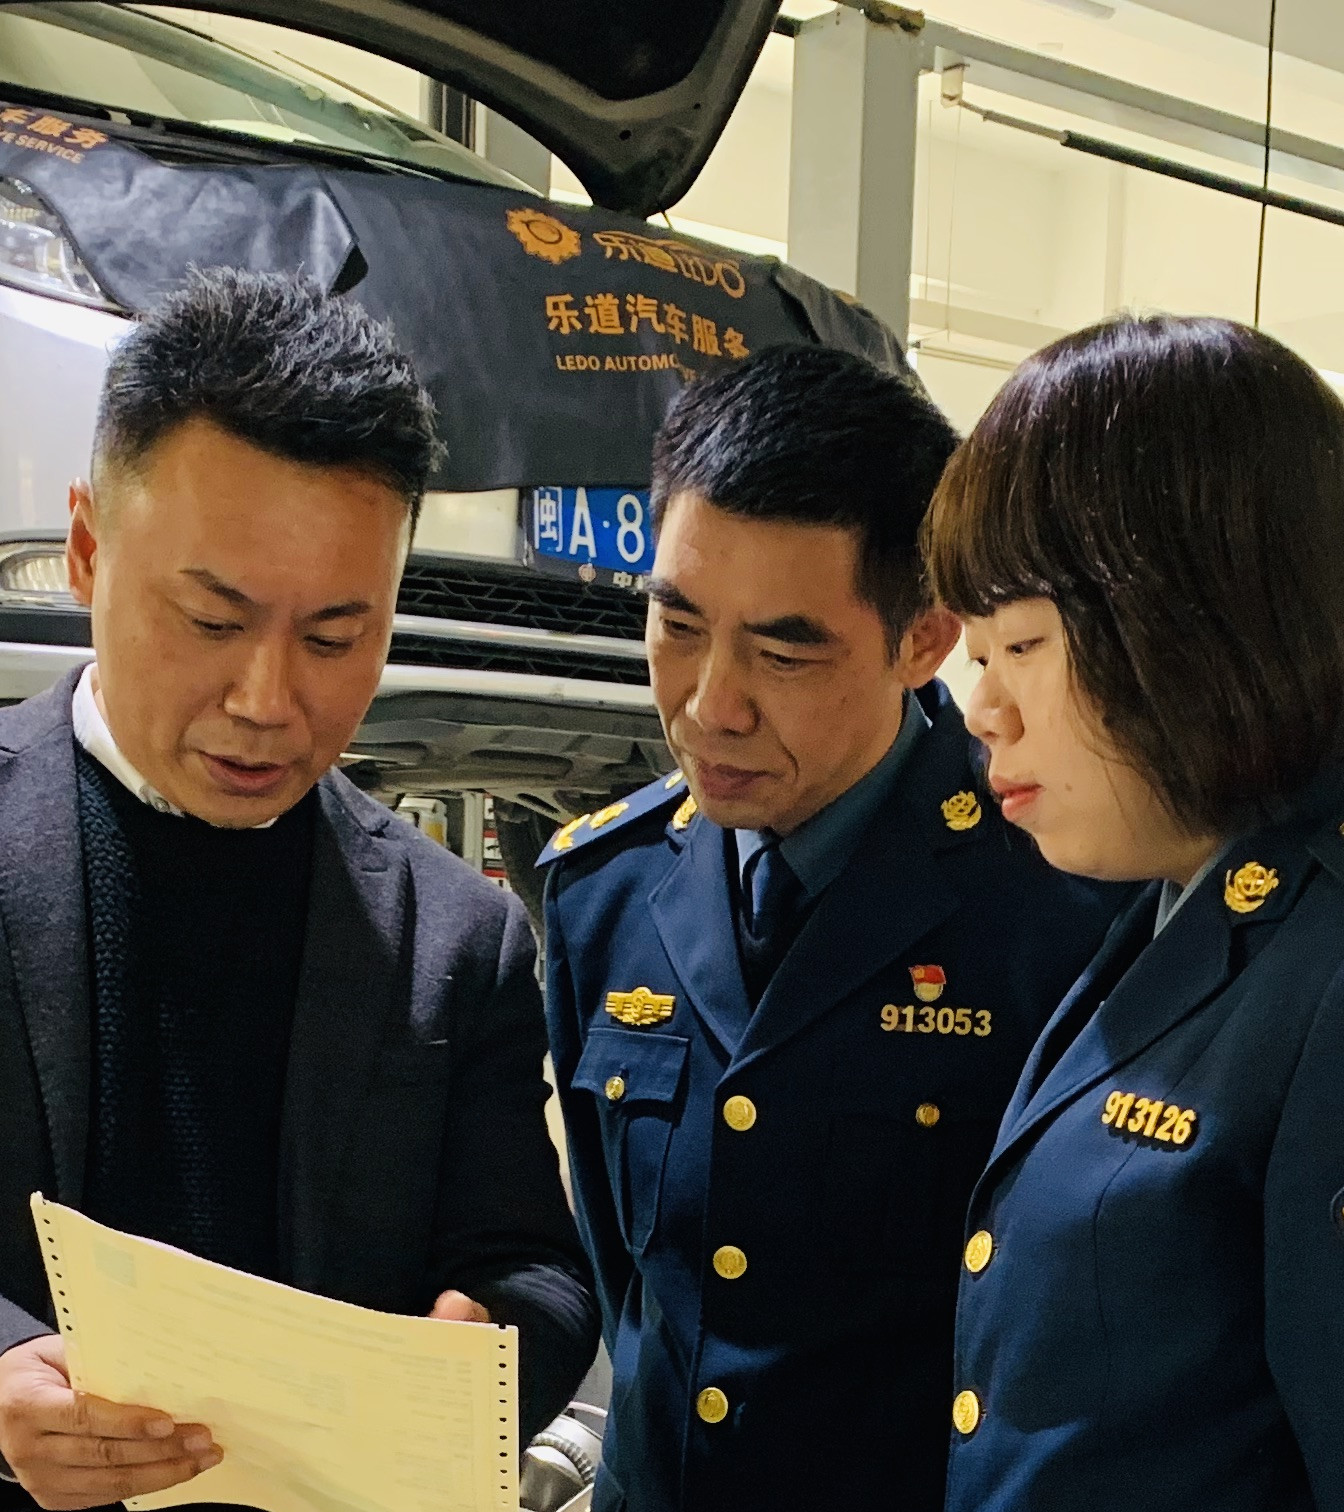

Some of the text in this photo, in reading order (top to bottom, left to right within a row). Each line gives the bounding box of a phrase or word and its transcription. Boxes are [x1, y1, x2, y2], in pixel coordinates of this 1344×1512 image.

[15, 133, 87, 164] SERVICE
[556, 355, 600, 371] LEDO
[880, 1003, 992, 1037] 913053
[1101, 1090, 1197, 1145] 913126
